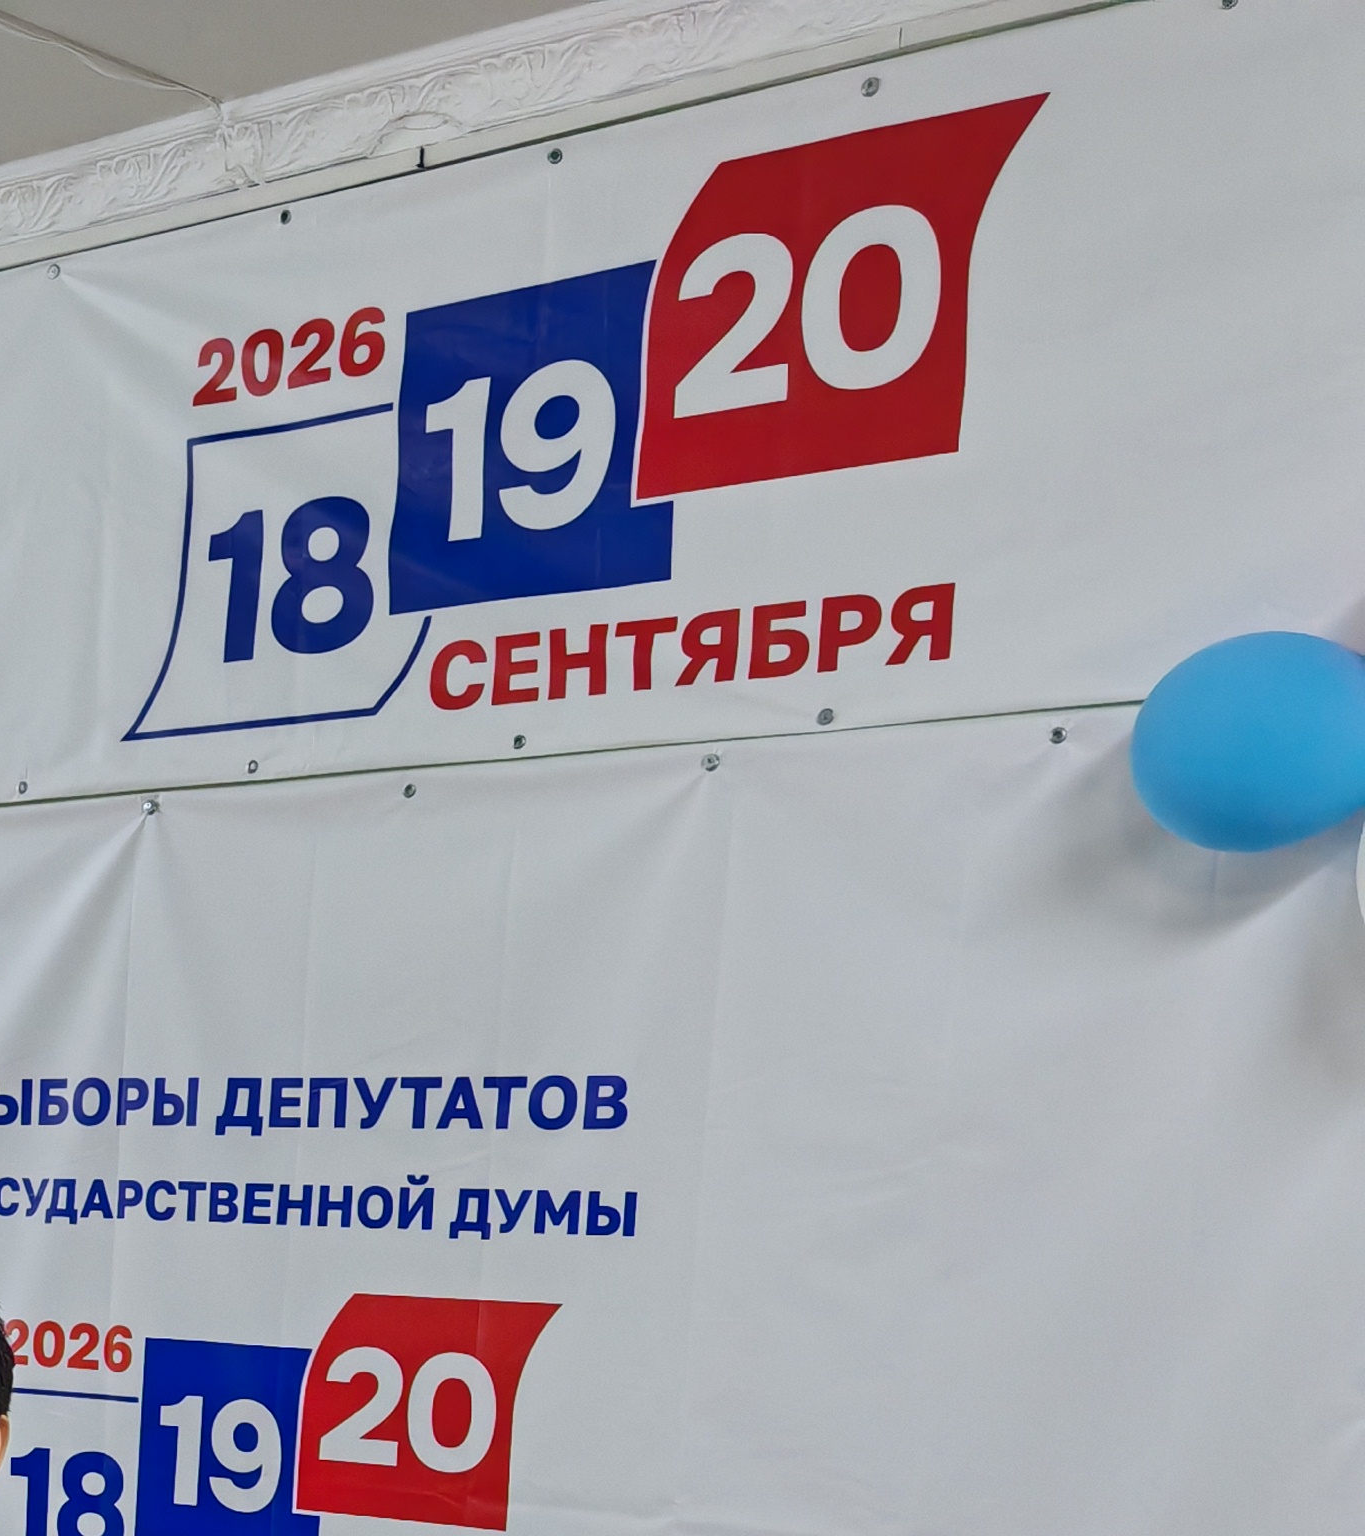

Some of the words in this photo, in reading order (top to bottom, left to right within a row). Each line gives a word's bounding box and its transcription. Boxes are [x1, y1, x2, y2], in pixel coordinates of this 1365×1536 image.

[193, 307, 385, 406] 2026
[208, 496, 374, 663] 18
[426, 360, 615, 541] 19
[674, 205, 940, 418] 20
[430, 583, 955, 710] СЕНТЯБРЯ
[215, 1075, 628, 1136] ДЕПУТАТОВ
[449, 1188, 637, 1240] ДУМЫ
[5, 1319, 133, 1373] 2026
[161, 1396, 281, 1512] 19
[319, 1347, 495, 1472] 20
